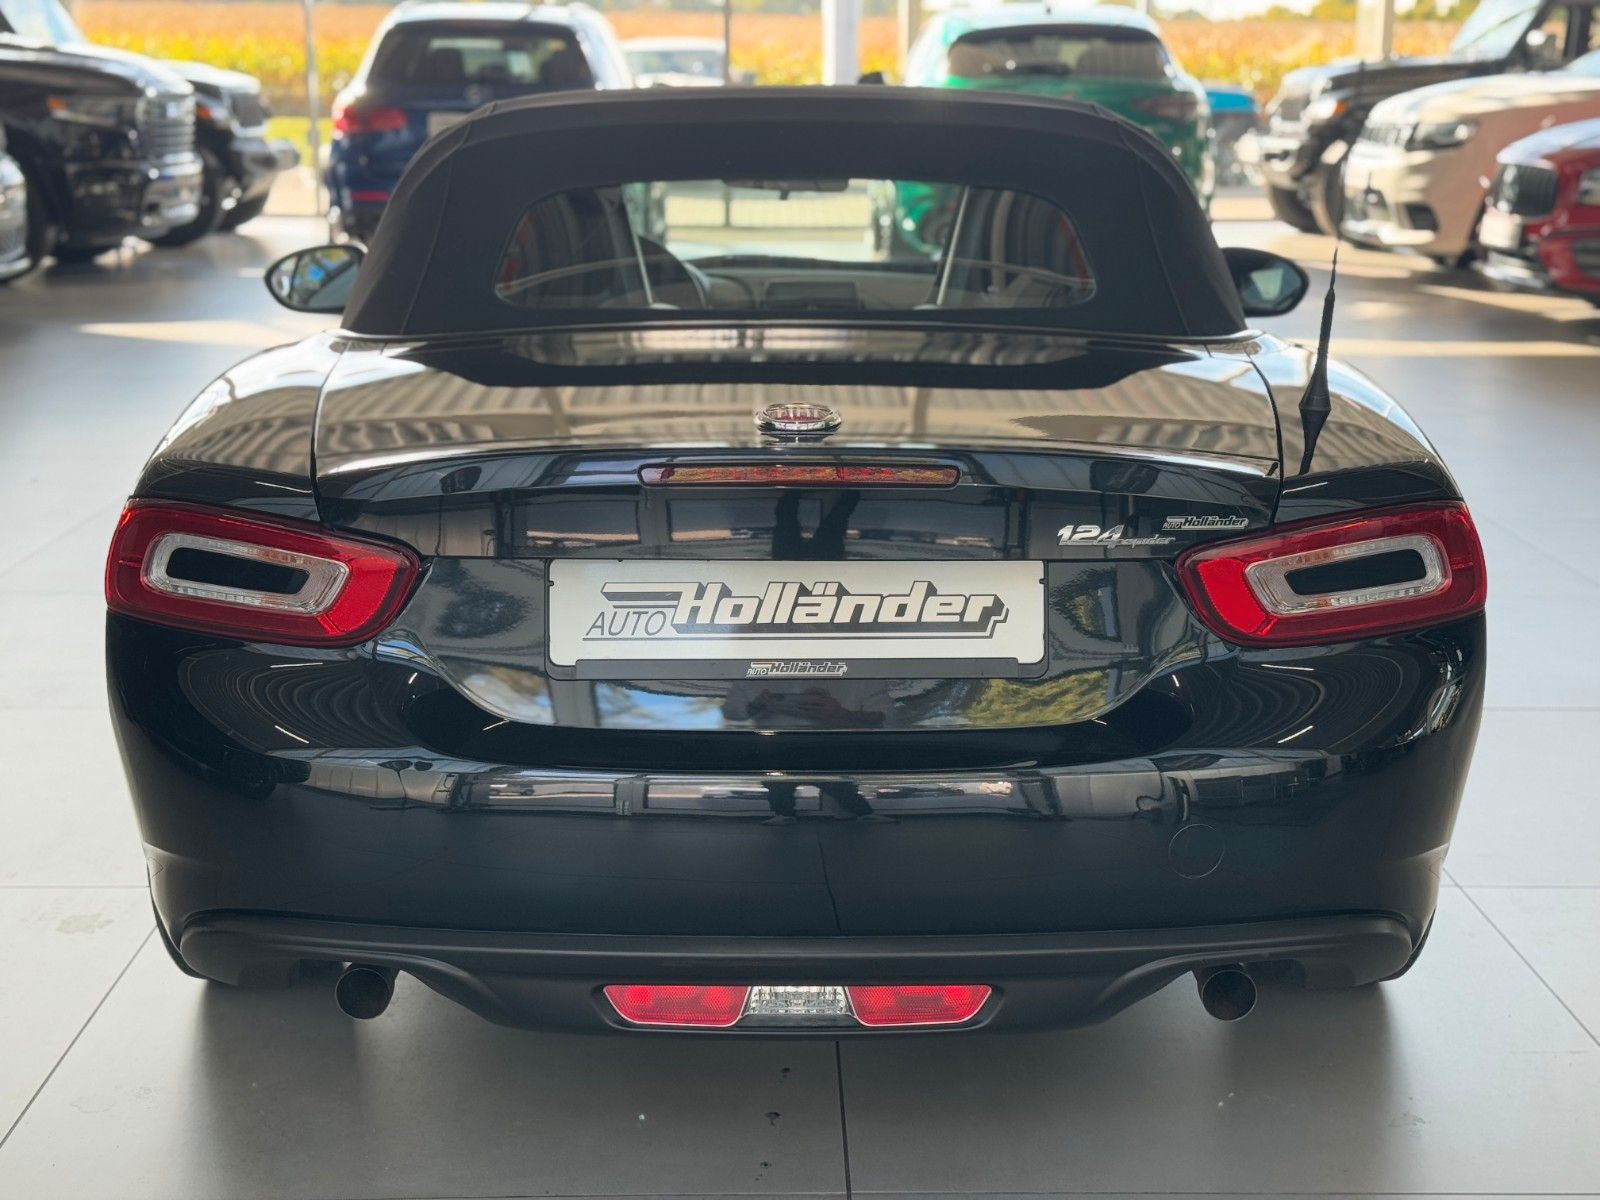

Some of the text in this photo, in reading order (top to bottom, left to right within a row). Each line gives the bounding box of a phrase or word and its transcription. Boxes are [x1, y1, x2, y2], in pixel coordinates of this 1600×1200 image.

[1162, 515, 1248, 529] AUTO Holländer
[1057, 524, 1124, 549] 124
[586, 580, 1006, 637] AUTO Holländer
[747, 661, 848, 676] AUTO Holländer
